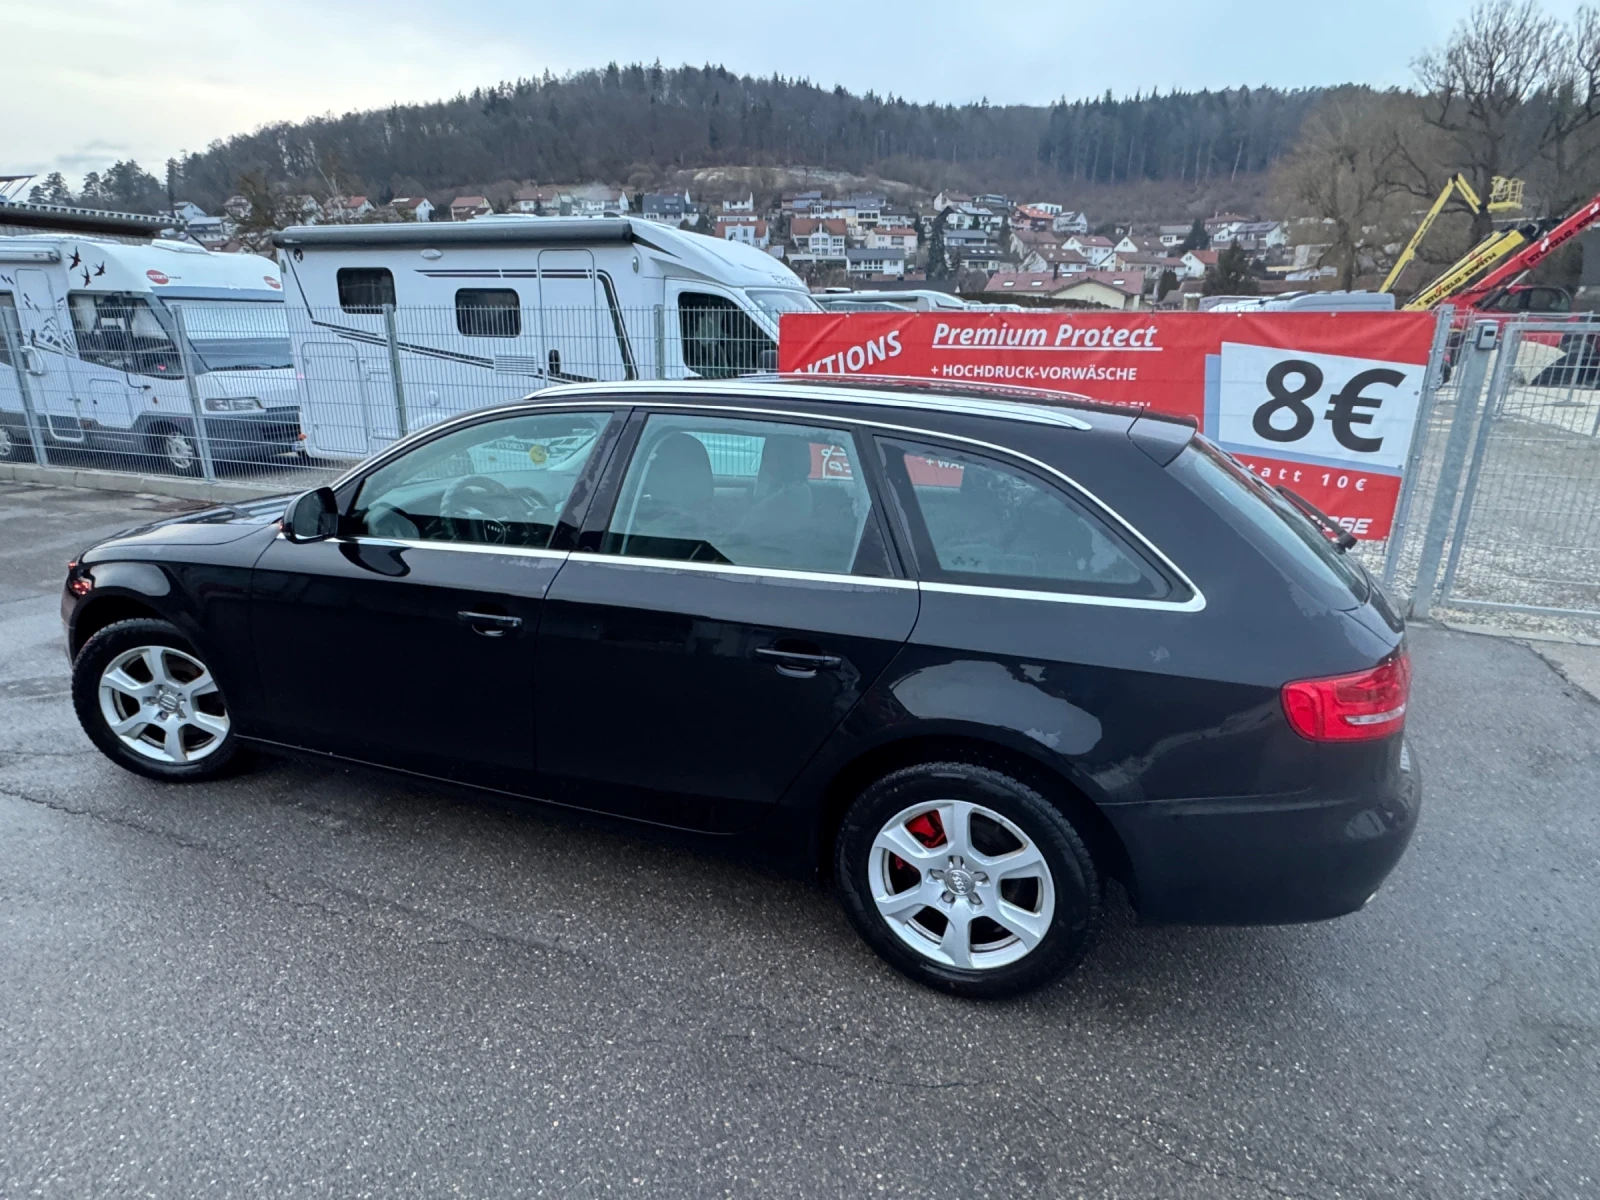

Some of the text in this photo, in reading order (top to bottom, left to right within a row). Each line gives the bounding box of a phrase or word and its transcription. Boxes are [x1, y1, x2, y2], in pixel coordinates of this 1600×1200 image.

[932, 323, 1157, 347] Premium Protect
[793, 330, 902, 374] TIONS
[942, 364, 1138, 381] HOCHDRUCK-VORWÄSCHE
[1252, 359, 1407, 453] 8€
[1321, 473, 1367, 491] 10€
